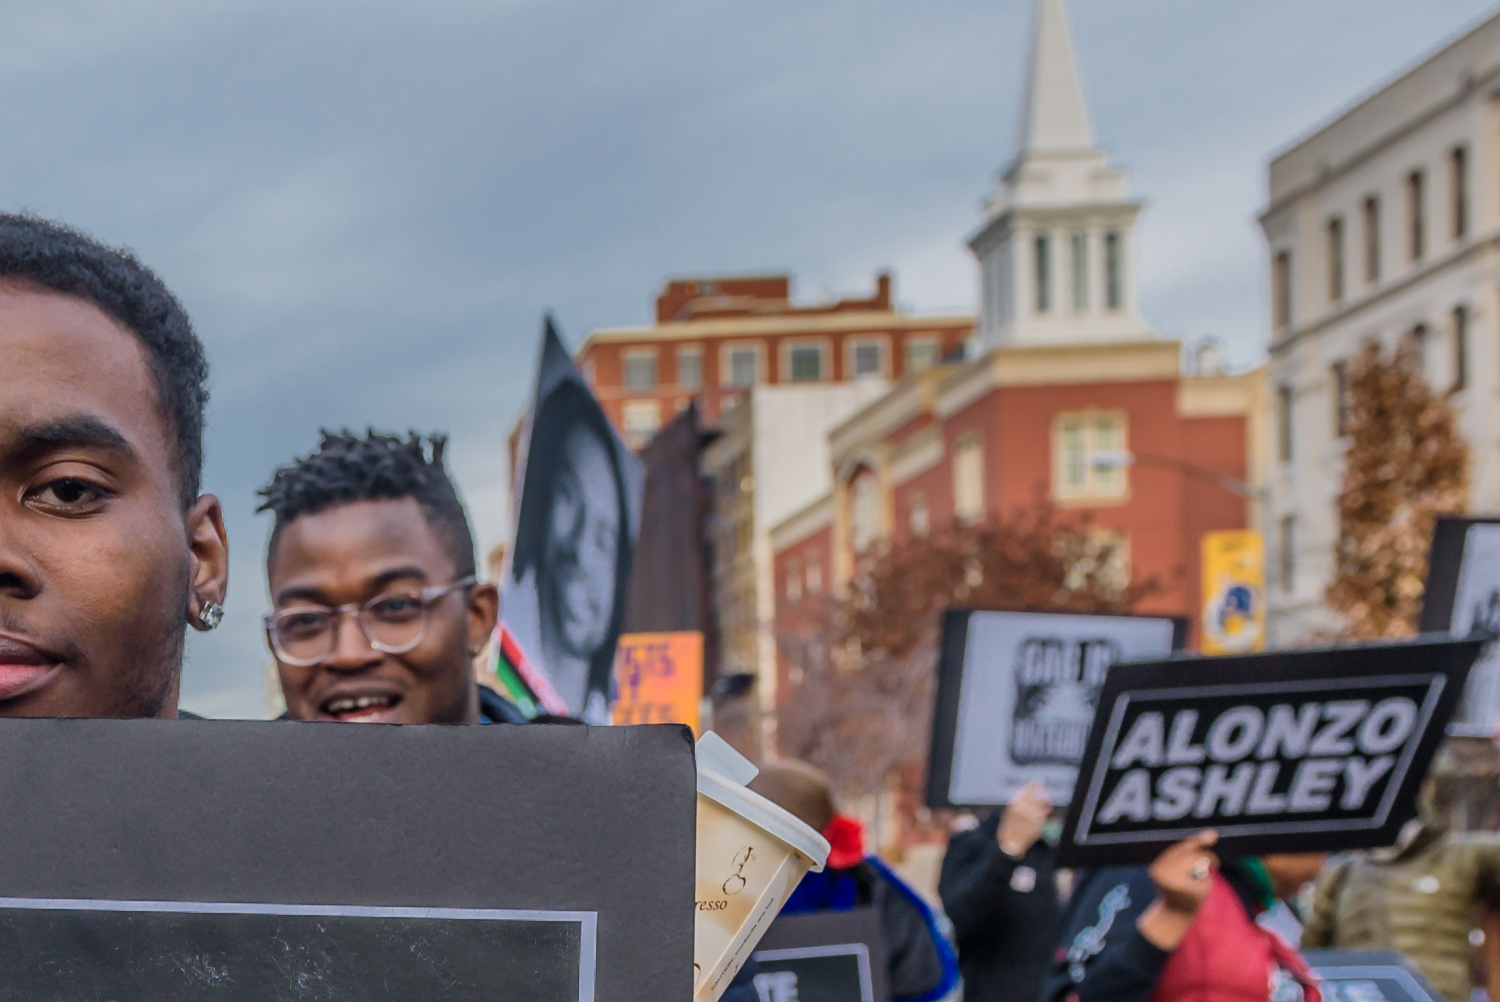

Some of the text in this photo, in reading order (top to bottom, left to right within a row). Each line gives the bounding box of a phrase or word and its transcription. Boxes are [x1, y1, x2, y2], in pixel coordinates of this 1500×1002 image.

[1110, 697, 1419, 770] ALONZO
[1097, 755, 1396, 824] ASHLEY
[694, 900, 728, 911] resso
